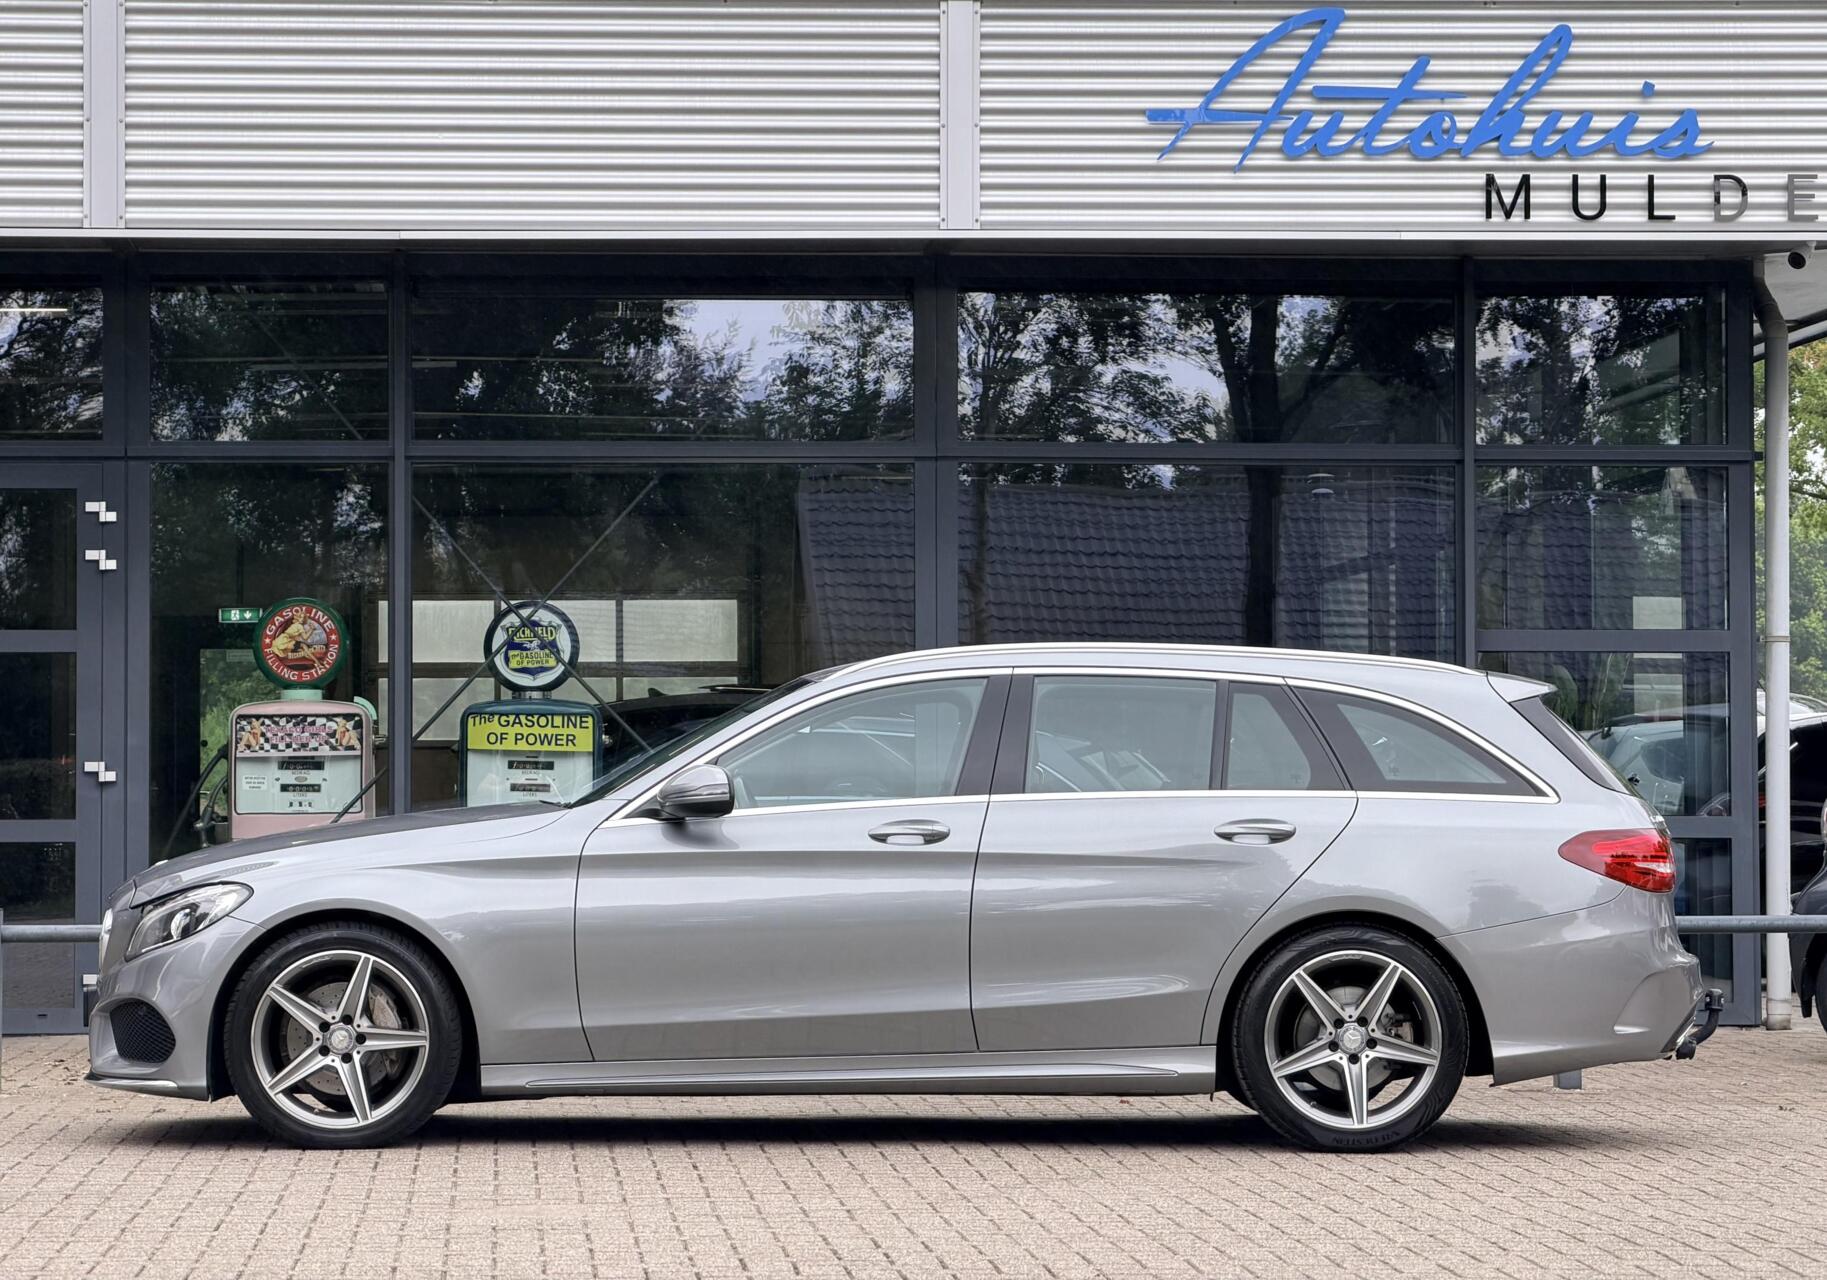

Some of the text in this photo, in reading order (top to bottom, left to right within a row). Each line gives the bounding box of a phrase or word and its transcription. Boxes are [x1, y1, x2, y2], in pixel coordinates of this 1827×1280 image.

[1145, 7, 1714, 173] Autohuis
[1485, 174, 1820, 222] MULDE
[266, 606, 335, 635] GASOLINE
[508, 626, 557, 641] ICHELD
[264, 643, 339, 681] FILLING STATION
[520, 651, 555, 660] GASOLINE
[470, 714, 590, 729] The GASOLINE
[486, 732, 577, 746] OF POWER
